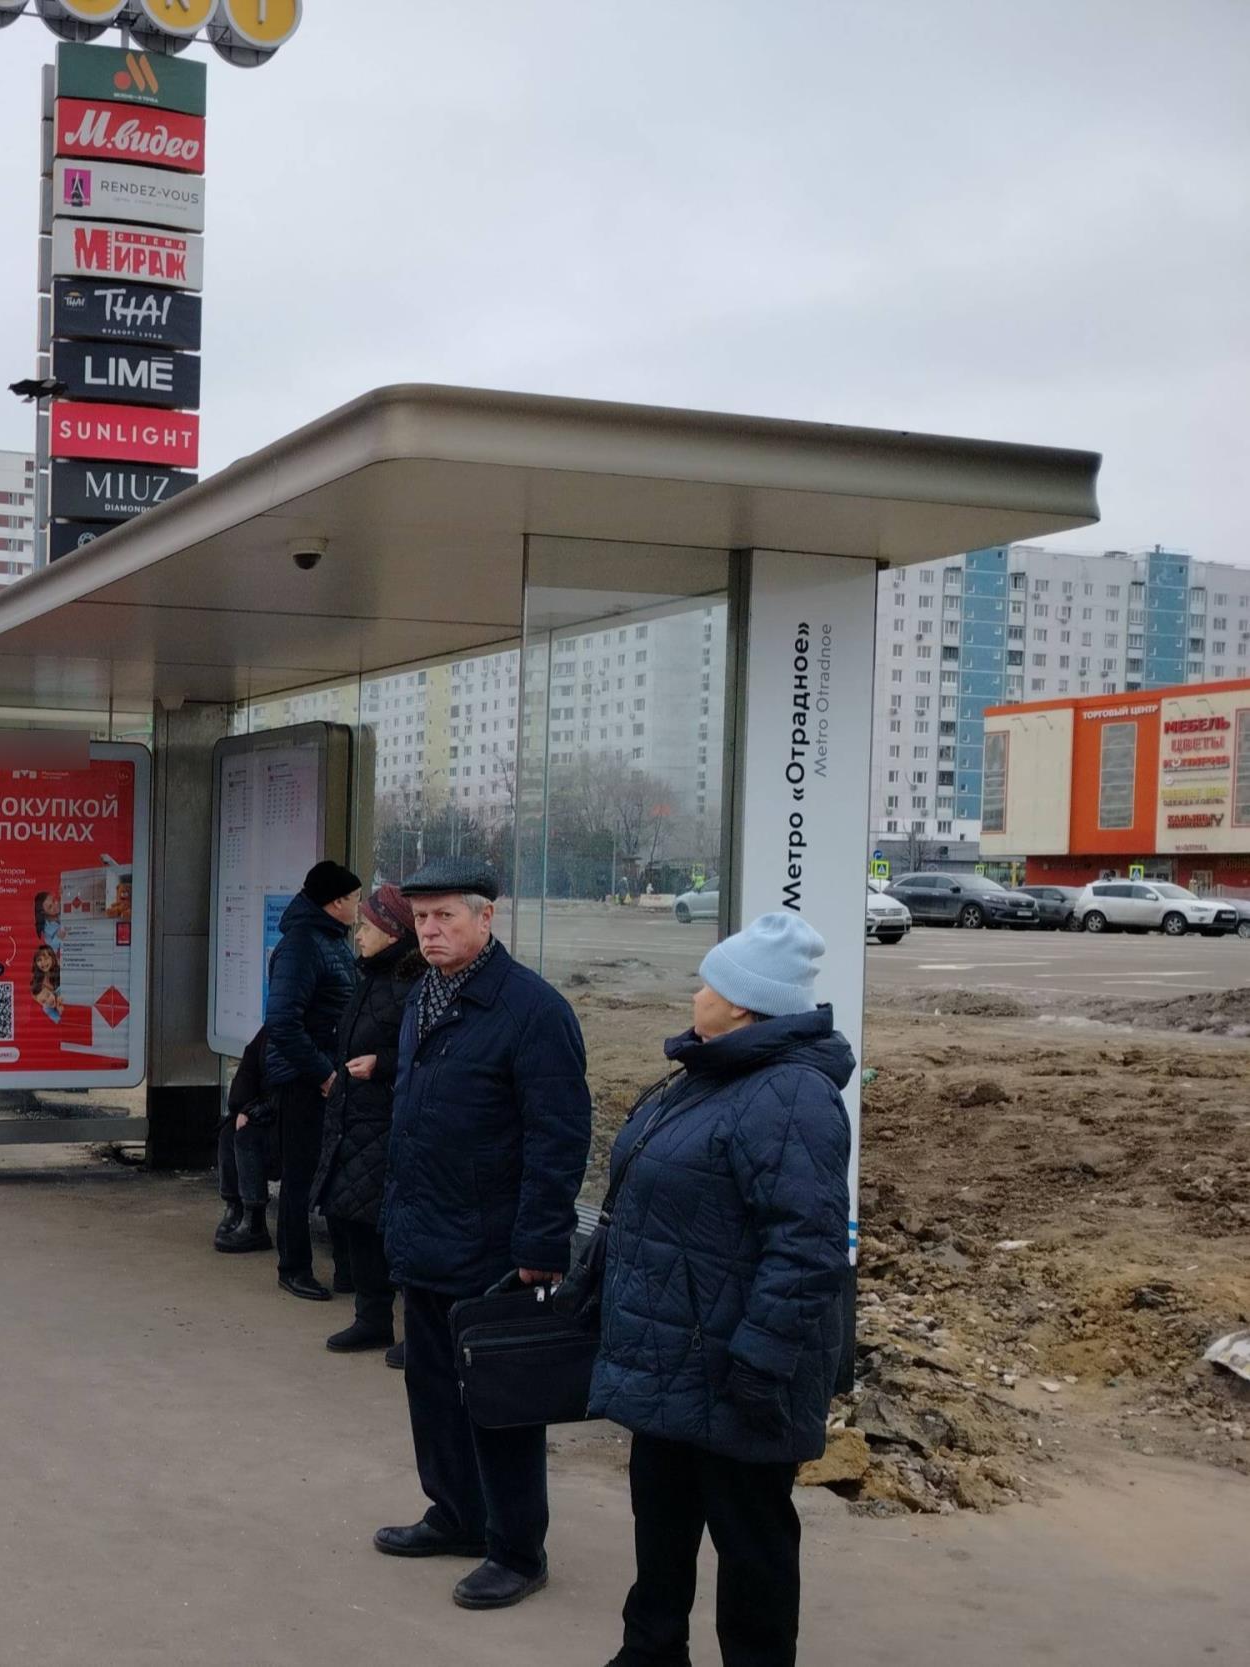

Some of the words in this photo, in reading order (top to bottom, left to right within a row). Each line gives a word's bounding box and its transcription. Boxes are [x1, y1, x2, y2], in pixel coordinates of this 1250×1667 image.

[100, 180, 199, 204] RENDEZ-VOUS
[74, 227, 187, 281] МИРАЖ
[117, 232, 186, 250] CINEMA
[94, 288, 172, 327] THAI
[59, 420, 192, 449] SUNLIGHT
[85, 471, 170, 503] MIUZ
[816, 623, 832, 713] Otradnoe
[785, 622, 810, 801] «Отрадное»
[1082, 705, 1129, 720] ТОРГОВЫЙ
[1130, 704, 1159, 716] ЦЕНТР
[1164, 716, 1231, 734] МЕБЕЛЬ
[814, 718, 828, 777] Metro
[782, 812, 808, 912] Метро
